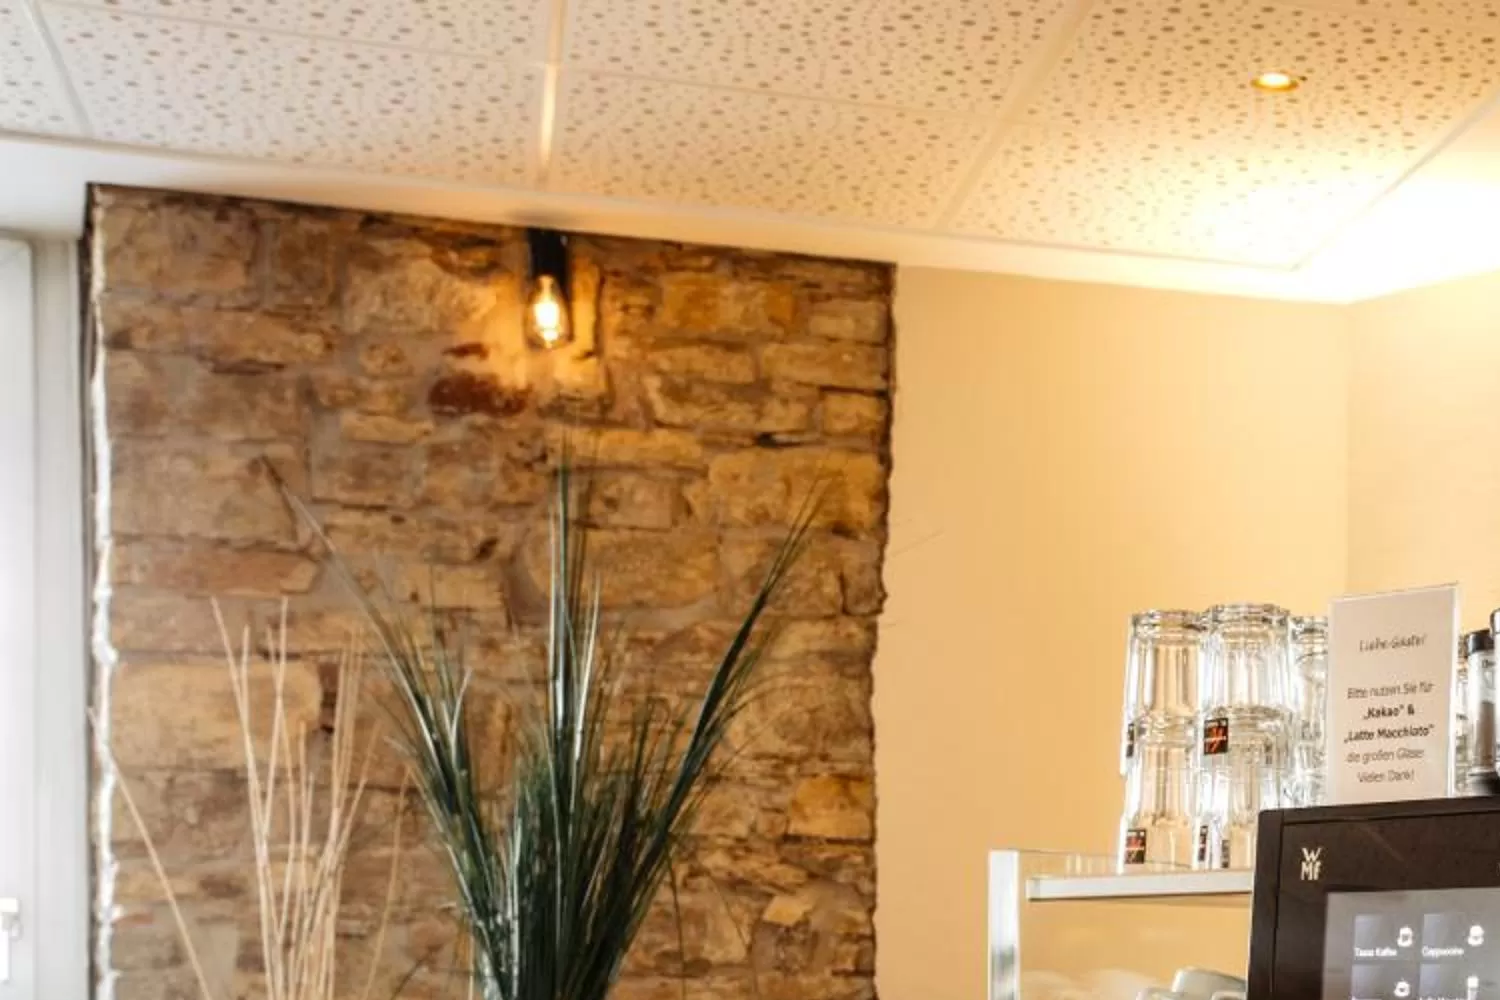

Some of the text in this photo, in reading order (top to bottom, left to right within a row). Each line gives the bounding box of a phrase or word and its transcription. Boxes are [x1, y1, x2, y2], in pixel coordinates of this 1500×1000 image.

[1347, 681, 1435, 700] Bitte nutzen Sie für
[1407, 704, 1415, 716] &
